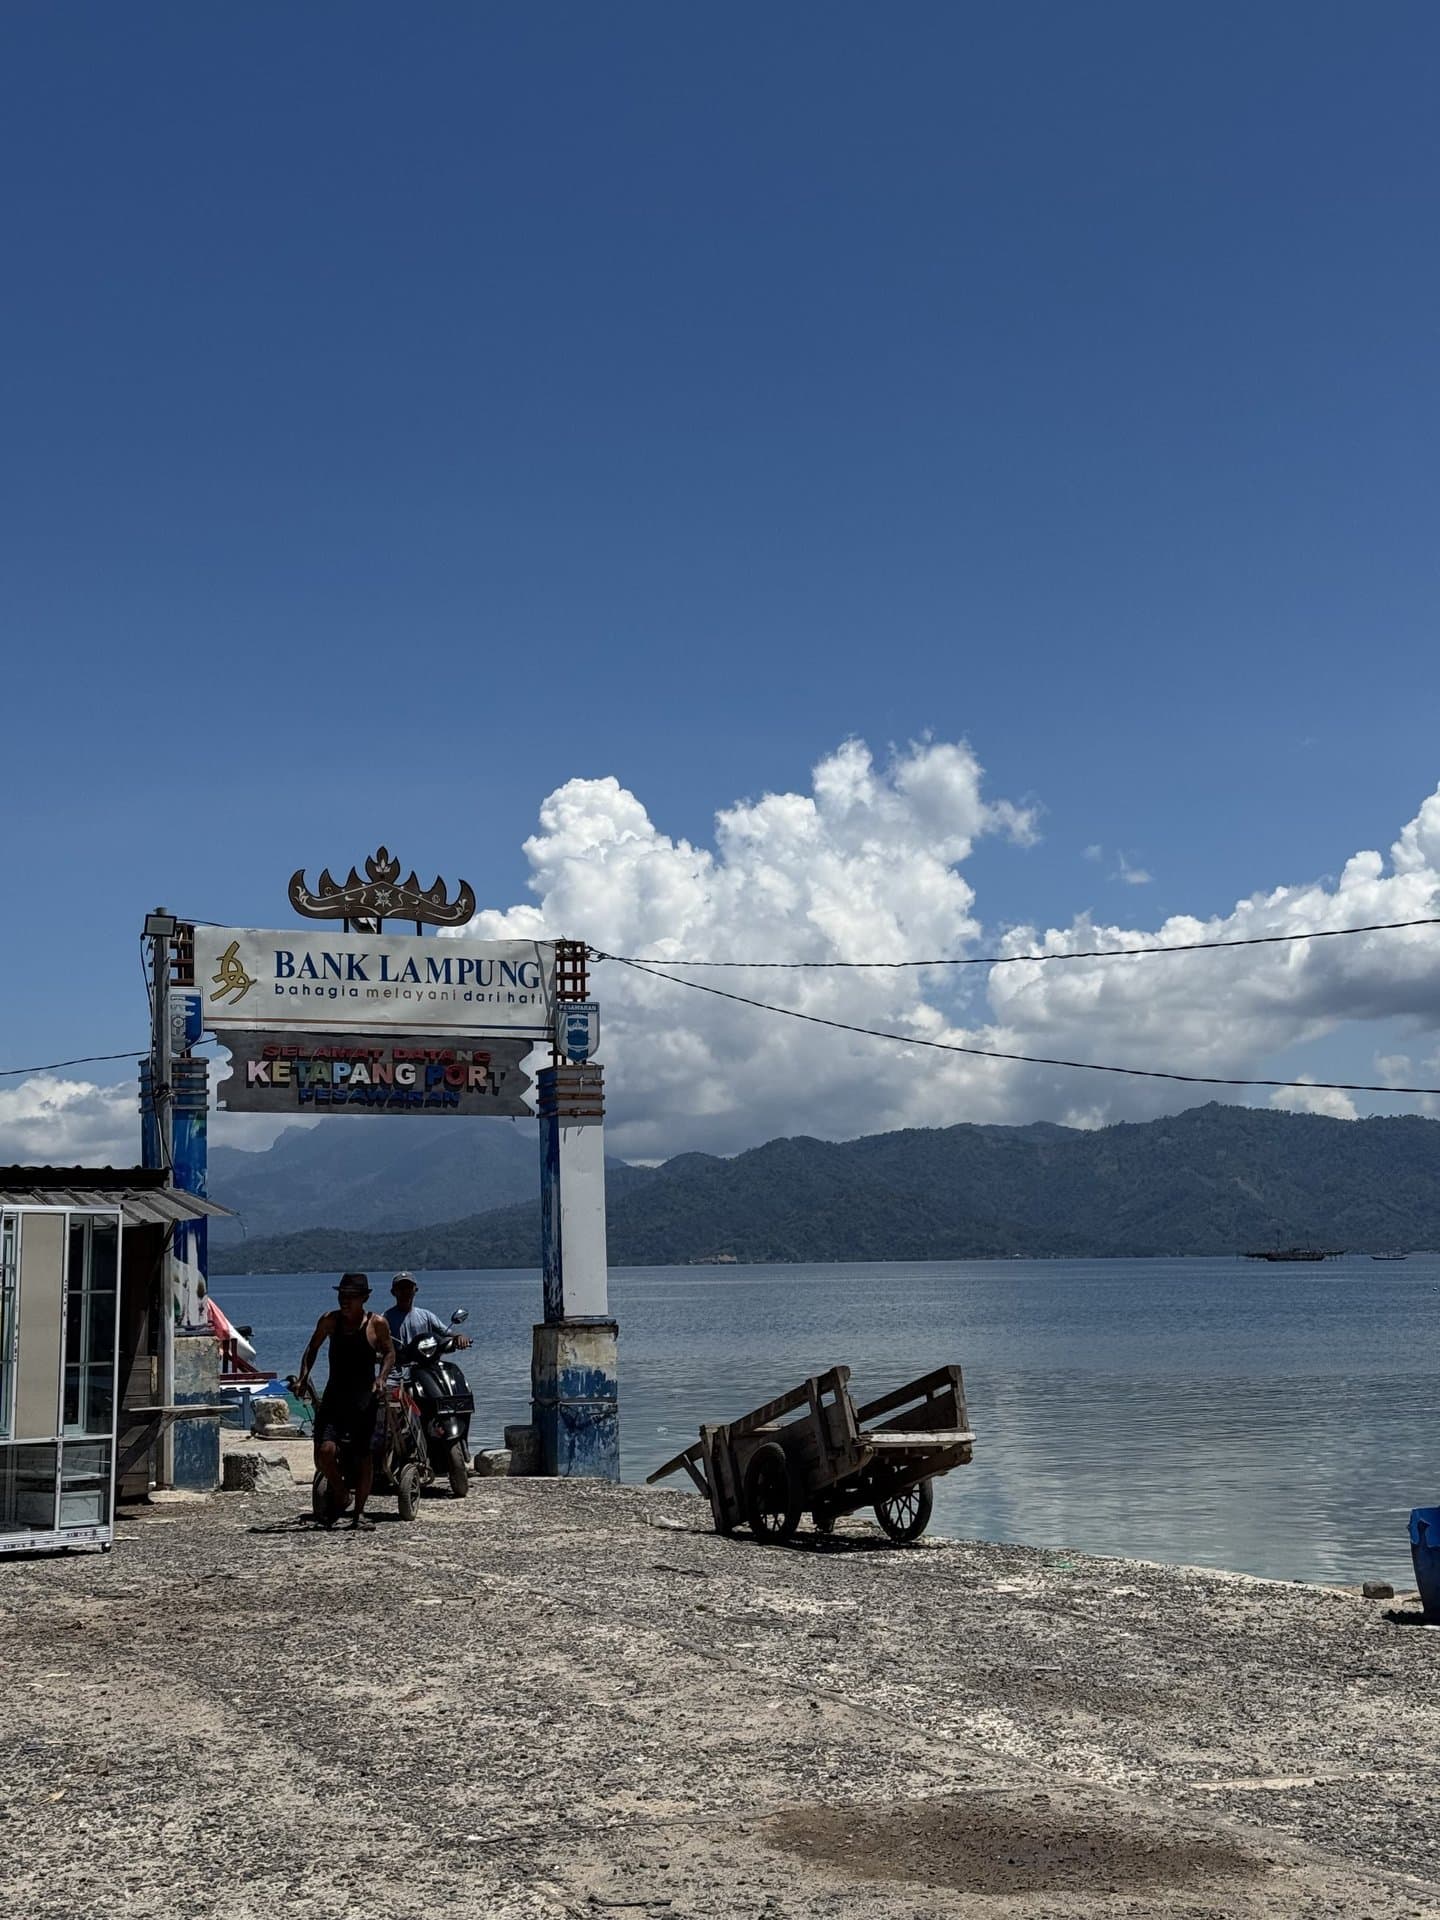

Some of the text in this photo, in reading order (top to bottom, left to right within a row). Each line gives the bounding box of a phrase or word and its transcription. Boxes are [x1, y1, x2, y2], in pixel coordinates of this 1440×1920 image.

[273, 950, 541, 989] BANK LAMPUNG
[274, 983, 543, 1005] bahagia melayani dari hati
[263, 1046, 492, 1063] SELAMAT DATANG
[247, 1060, 506, 1091] KETAPANG PORT
[298, 1087, 460, 1106] PESAWARAN
